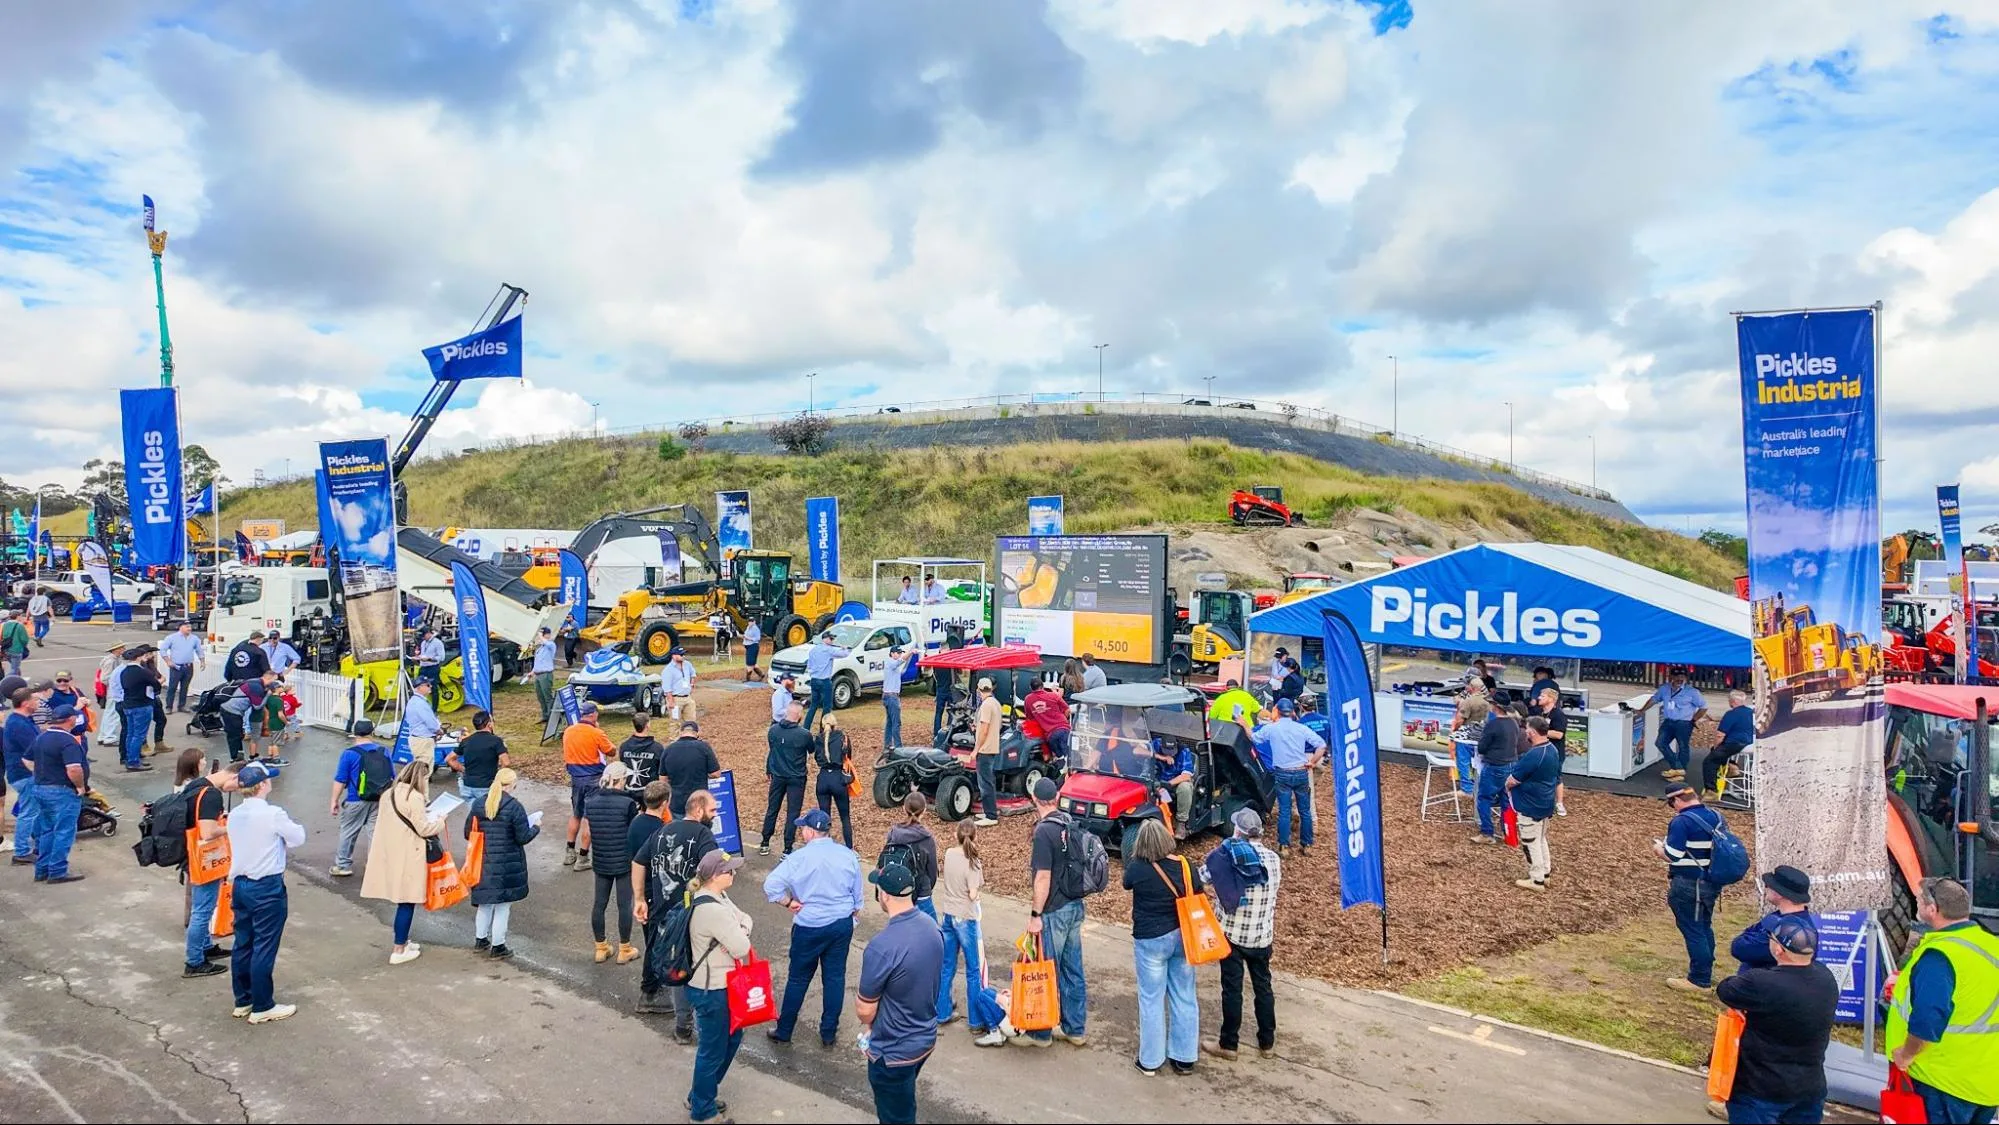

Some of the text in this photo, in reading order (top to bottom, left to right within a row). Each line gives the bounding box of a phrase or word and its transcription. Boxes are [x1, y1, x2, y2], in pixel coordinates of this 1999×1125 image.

[441, 340, 508, 362] Pickles
[1756, 352, 1837, 379] Pickles
[1762, 426, 1847, 441] Australi's leading
[327, 455, 370, 466] Pickles
[329, 462, 385, 475] Industrial
[140, 430, 172, 524] Pickles
[818, 511, 829, 549] Pickles
[457, 539, 480, 553] CJD
[821, 560, 829, 581] wered
[931, 616, 976, 633] Pickles
[1371, 585, 1602, 647] Pickles
[1341, 697, 1366, 858] Pickles
[1809, 870, 1886, 884] es.com.au
[1835, 1009, 1856, 1018] ickles
